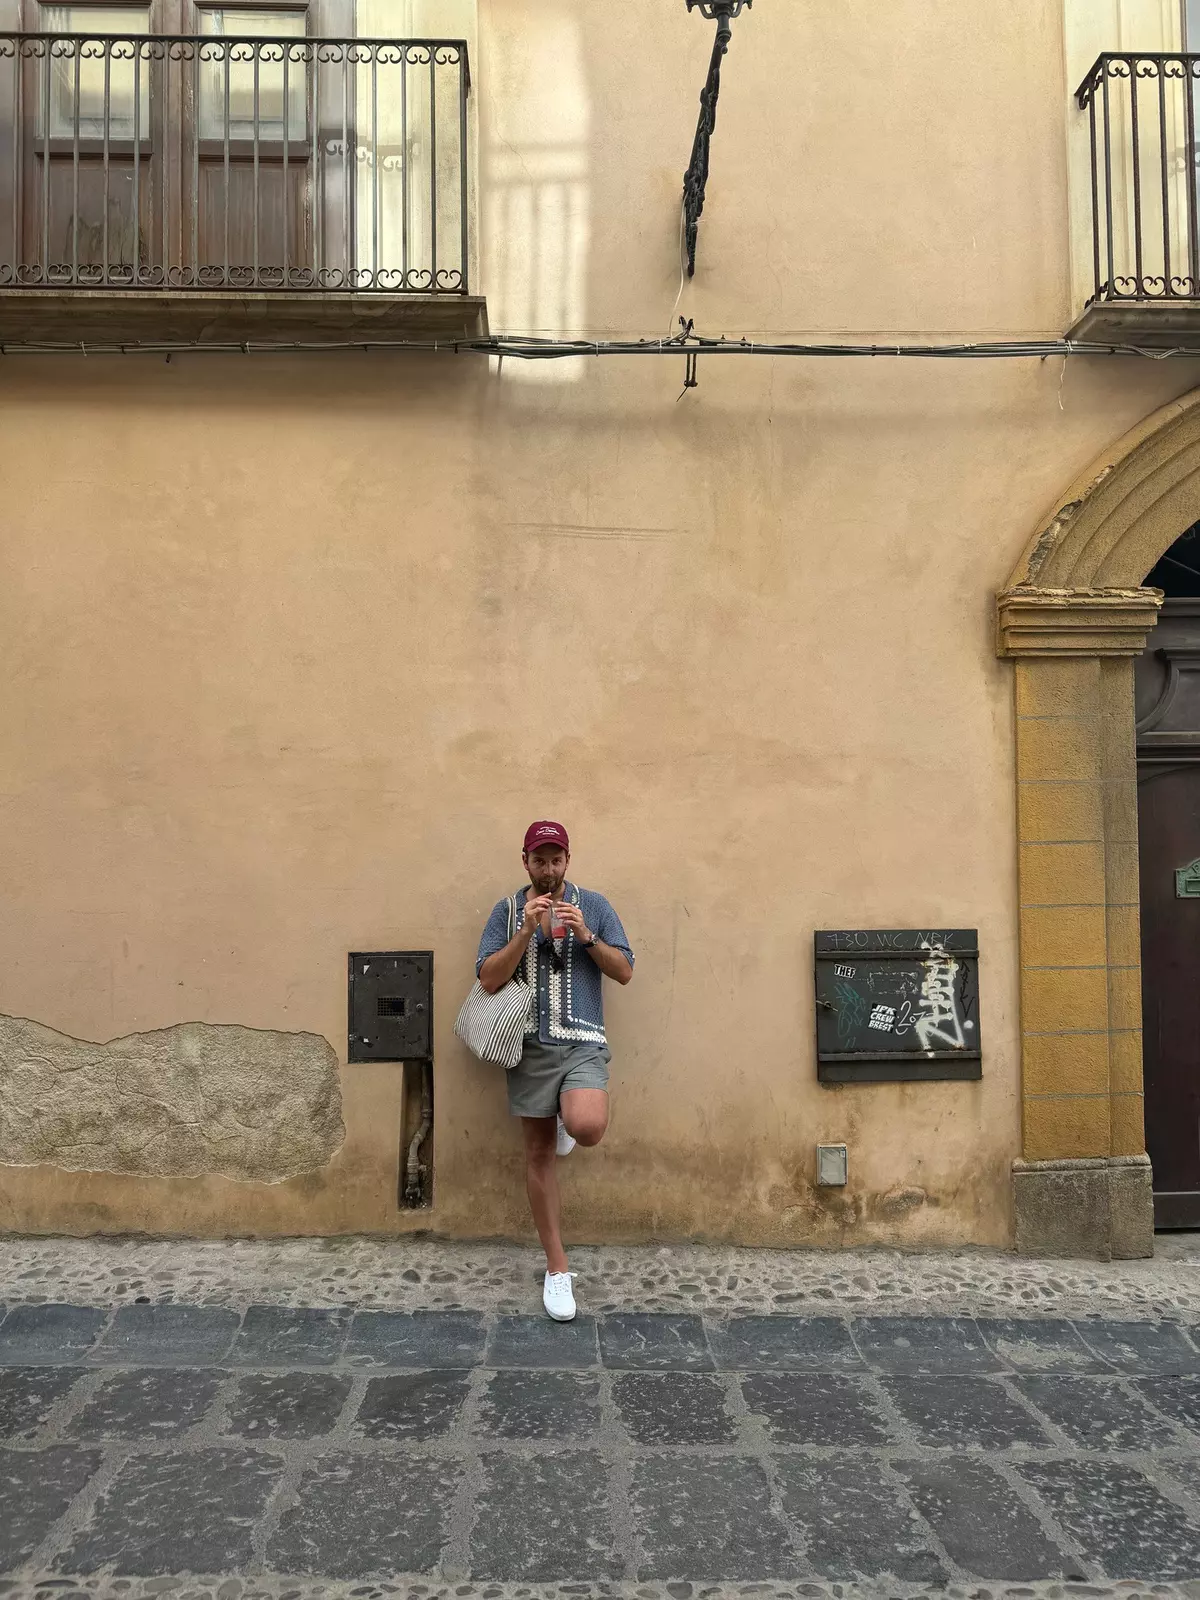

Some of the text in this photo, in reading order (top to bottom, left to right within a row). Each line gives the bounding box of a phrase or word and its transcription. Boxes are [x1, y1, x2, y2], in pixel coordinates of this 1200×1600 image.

[871, 1004, 897, 1015] JPK
[870, 1012, 895, 1023] CREW
[868, 1020, 893, 1032] BREST
